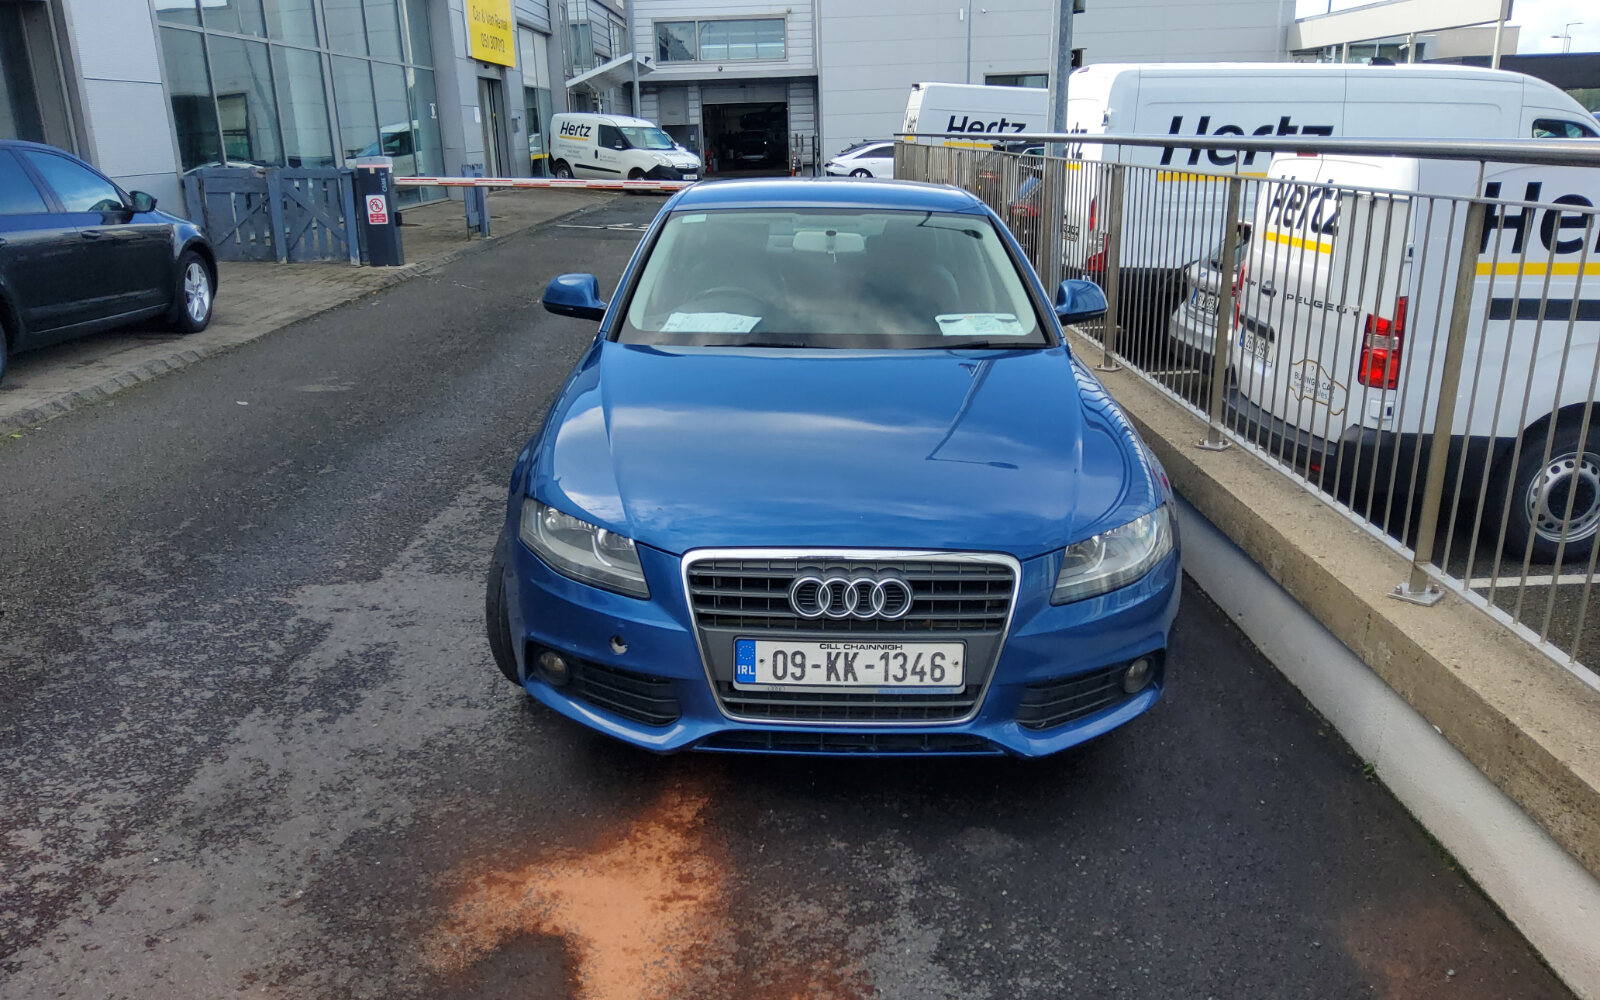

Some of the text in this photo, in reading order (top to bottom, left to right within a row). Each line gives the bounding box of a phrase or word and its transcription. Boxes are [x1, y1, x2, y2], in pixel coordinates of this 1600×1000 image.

[560, 121, 592, 138] Hertz
[947, 115, 1027, 139] Hertz
[1159, 115, 1335, 166] Her
[1479, 181, 1600, 254] He
[843, 643, 903, 651] CHAINNIGH
[737, 664, 755, 675] IRL
[772, 650, 946, 683] 09-KK-1346
